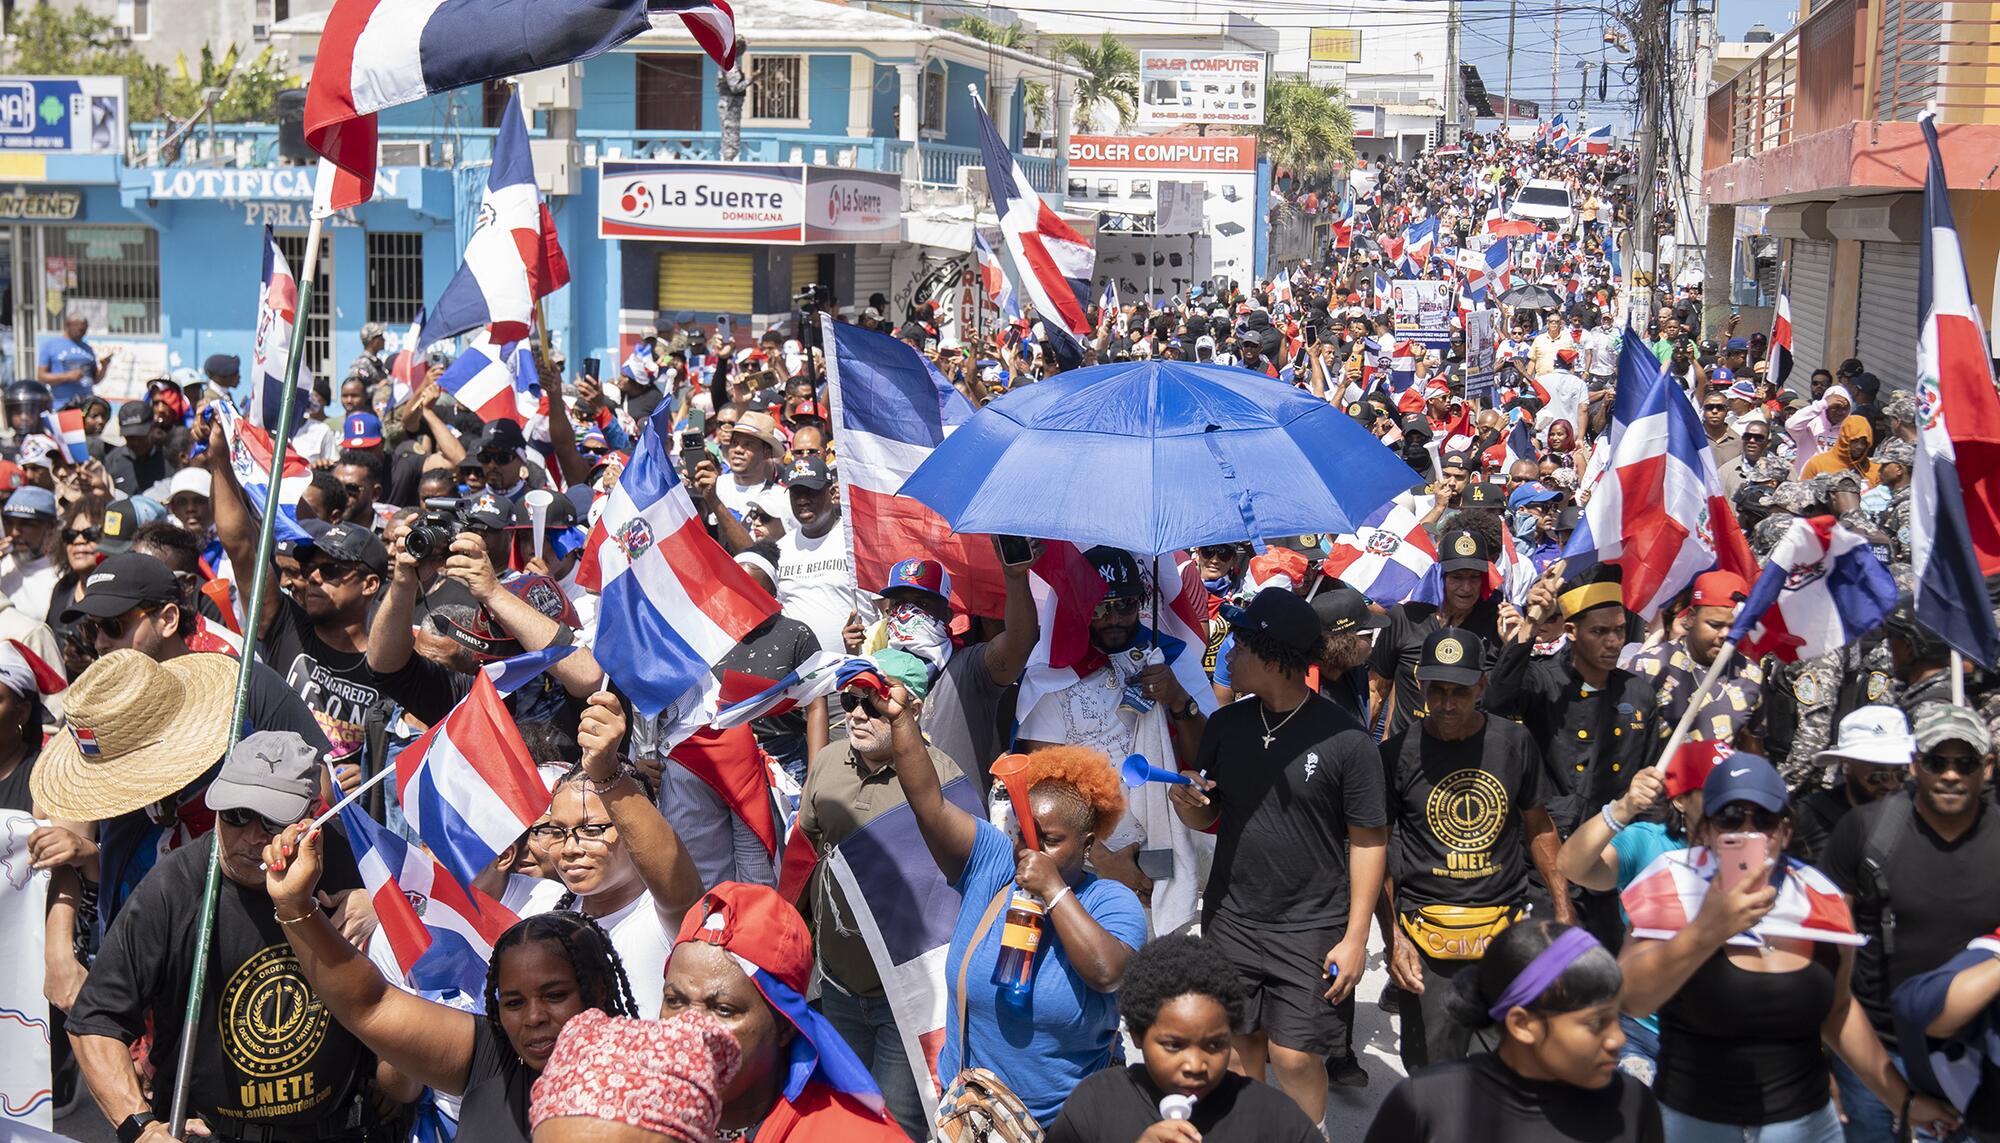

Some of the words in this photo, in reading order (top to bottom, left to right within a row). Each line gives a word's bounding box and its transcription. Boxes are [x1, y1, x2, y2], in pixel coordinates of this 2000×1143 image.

[1146, 57, 1187, 71] SOLER
[1190, 58, 1259, 72] COMPUTER
[1069, 143, 1130, 161] SOLER
[1134, 145, 1239, 163] COMPUTER
[151, 170, 400, 198] LOTIFICAN
[661, 184, 687, 206] La
[842, 189, 851, 212] La
[722, 211, 783, 222] DOMINICANA
[353, 420, 364, 435] D
[1473, 486, 1484, 501] LA
[779, 563, 802, 577] TRUE
[806, 558, 849, 574] RELIGION
[1098, 563, 1116, 583] NY
[454, 629, 490, 651] Canon
[258, 963, 286, 979] ORDEN
[238, 1027, 266, 1054] DEFENSA
[269, 1046, 280, 1054] DE
[283, 1042, 294, 1051] LA
[295, 1016, 316, 1043] PATRIA
[240, 1071, 315, 1107] ÚNETE
